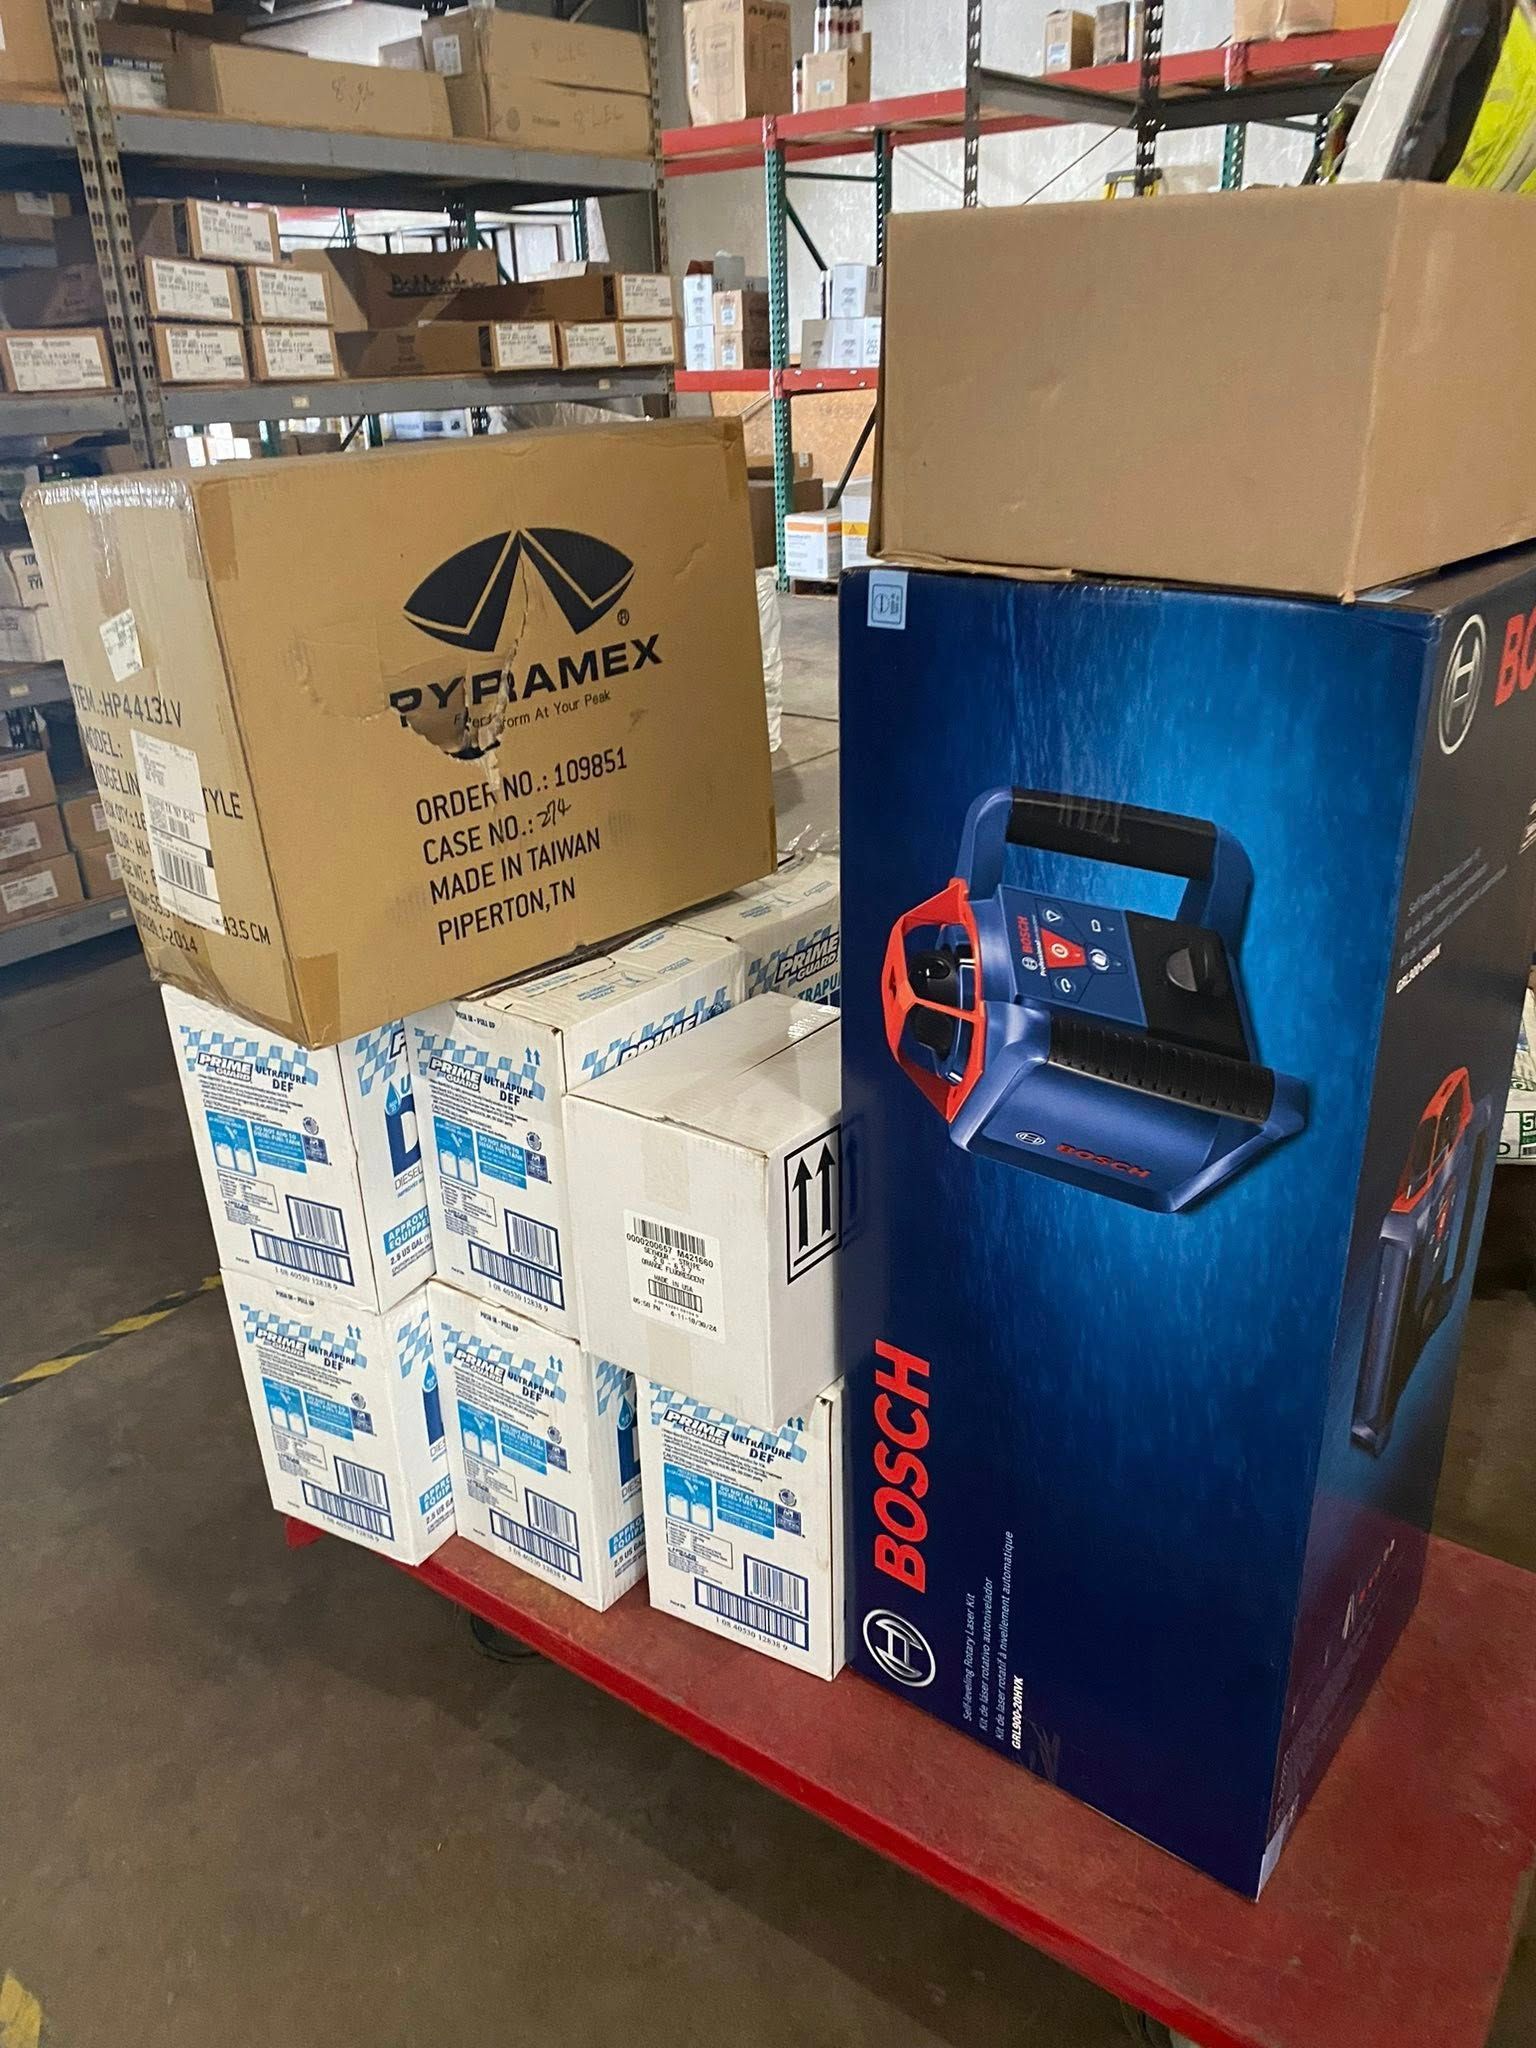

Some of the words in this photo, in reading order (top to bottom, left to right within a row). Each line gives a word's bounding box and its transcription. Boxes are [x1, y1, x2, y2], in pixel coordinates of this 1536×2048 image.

[389, 634, 663, 728] PYRAMEX
[535, 706, 549, 721] At
[553, 699, 580, 717] Your
[585, 690, 611, 707] Peak
[416, 783, 498, 825] ORDER
[555, 746, 628, 787] 109851
[424, 827, 483, 864] CASE
[430, 862, 496, 905] MADE
[501, 853, 523, 881] IN
[527, 827, 601, 872] TAIWAN
[1017, 915, 1033, 954] BOSCH
[778, 934, 839, 980] PRIME
[797, 953, 838, 981] GUARD
[199, 1053, 252, 1074] PRIME
[215, 1067, 252, 1083] GUARD
[255, 1065, 307, 1085] ULTRAPURE
[430, 1058, 483, 1084] PRIME
[272, 1077, 294, 1093] DEF
[445, 1074, 480, 1092] GUARD
[484, 1075, 534, 1099] ULTRAPURE
[500, 1091, 521, 1106] DEF
[1057, 1142, 1151, 1178] BOSCH
[389, 1216, 429, 1250] EQUIPPE
[256, 1328, 306, 1351] PRIME
[308, 1344, 356, 1366] ULTRAPURE
[323, 1358, 344, 1372] DEF
[455, 1350, 506, 1375] PRIME
[507, 1372, 555, 1399] ULTRAPURE
[522, 1386, 542, 1402] DEF
[665, 1410, 730, 1440] PRIME
[682, 1425, 727, 1447] GUARD
[732, 1432, 792, 1460] ULTRAPURE
[749, 1448, 775, 1464] DEF
[874, 1338, 930, 1594] BOSCH
[1002, 1530, 1015, 1595] automatique
[965, 1592, 976, 1608] Kit
[983, 1576, 993, 1643] autonivelador
[965, 1607, 975, 1636] Laser
[999, 1594, 1010, 1651] nivellement
[964, 1636, 976, 1667] Rotary
[981, 1644, 990, 1680] rotativo
[997, 1658, 1007, 1690] rotatif
[963, 1668, 975, 1721] Self-leveling
[996, 1690, 1006, 1714] laser
[979, 1704, 989, 1717] de
[979, 1716, 988, 1731] Kit
[995, 1714, 1005, 1727] de
[1011, 1674, 1024, 1750] GRL900-20HVK
[995, 1726, 1005, 1740] Kit
